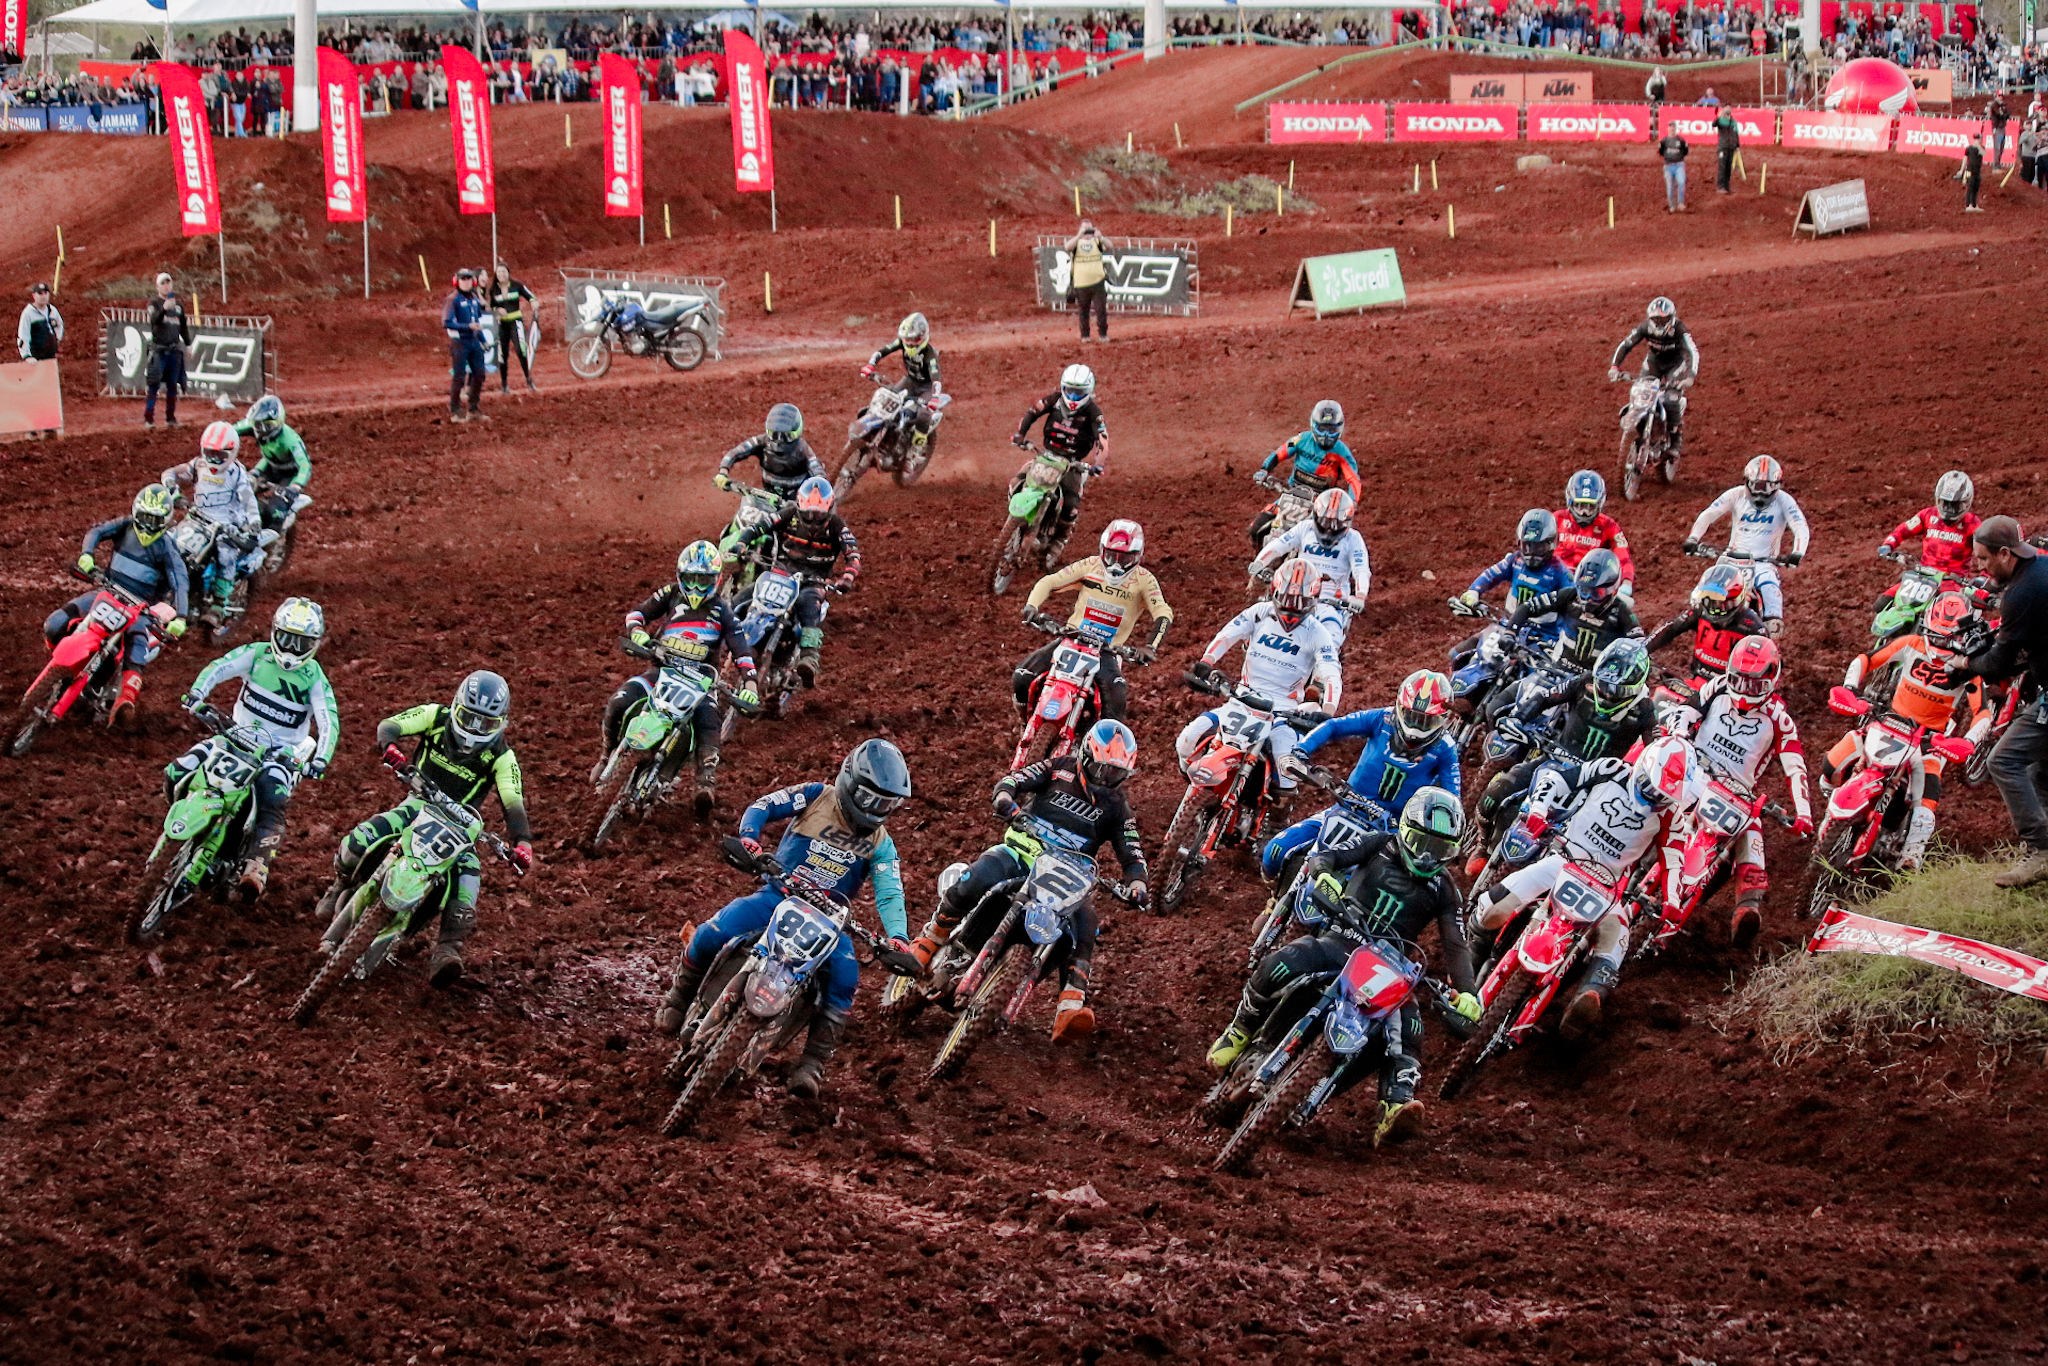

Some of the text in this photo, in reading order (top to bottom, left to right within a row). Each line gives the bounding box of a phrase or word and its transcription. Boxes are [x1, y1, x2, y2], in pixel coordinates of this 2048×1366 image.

[1470, 80, 1504, 98] KTM
[1543, 79, 1575, 96] KTM
[736, 62, 756, 149] BIKER
[328, 83, 349, 176] BIKER
[456, 80, 480, 170] BIKER
[610, 86, 628, 173] BIKER
[1284, 116, 1372, 132] HONDA
[1407, 116, 1504, 132] HONDA
[1540, 117, 1636, 133] HONDA
[1794, 124, 1879, 142] HONDA
[174, 96, 202, 189] BIKER
[1905, 130, 1969, 148] HONDA
[1342, 262, 1390, 294] Sicredi
[1741, 510, 1774, 524] KTM
[1304, 544, 1340, 558] KTM
[758, 580, 794, 606] 185
[1900, 578, 1933, 601] 218
[1258, 633, 1301, 656] KTM
[1055, 649, 1100, 674] 97
[1276, 660, 1297, 670] TORK
[468, 677, 478, 694] FOX
[654, 681, 696, 711] 110
[1904, 684, 1945, 704] HONDA
[1223, 711, 1264, 744] 34
[1706, 742, 1744, 764] HONDA
[1712, 733, 1748, 756] RACING
[1874, 734, 1906, 760] 7
[206, 750, 256, 789] 134
[1700, 798, 1741, 834] 30
[413, 820, 456, 860] 45
[1584, 830, 1622, 860] HONDA
[1590, 822, 1626, 852] RACING
[808, 856, 848, 876] BLADE
[1032, 866, 1087, 900] 2
[1554, 880, 1604, 920] 60
[778, 910, 832, 958] 891
[1837, 926, 1905, 948] HONDA
[1940, 947, 2024, 978] HONDA
[1358, 964, 1398, 999] 1
